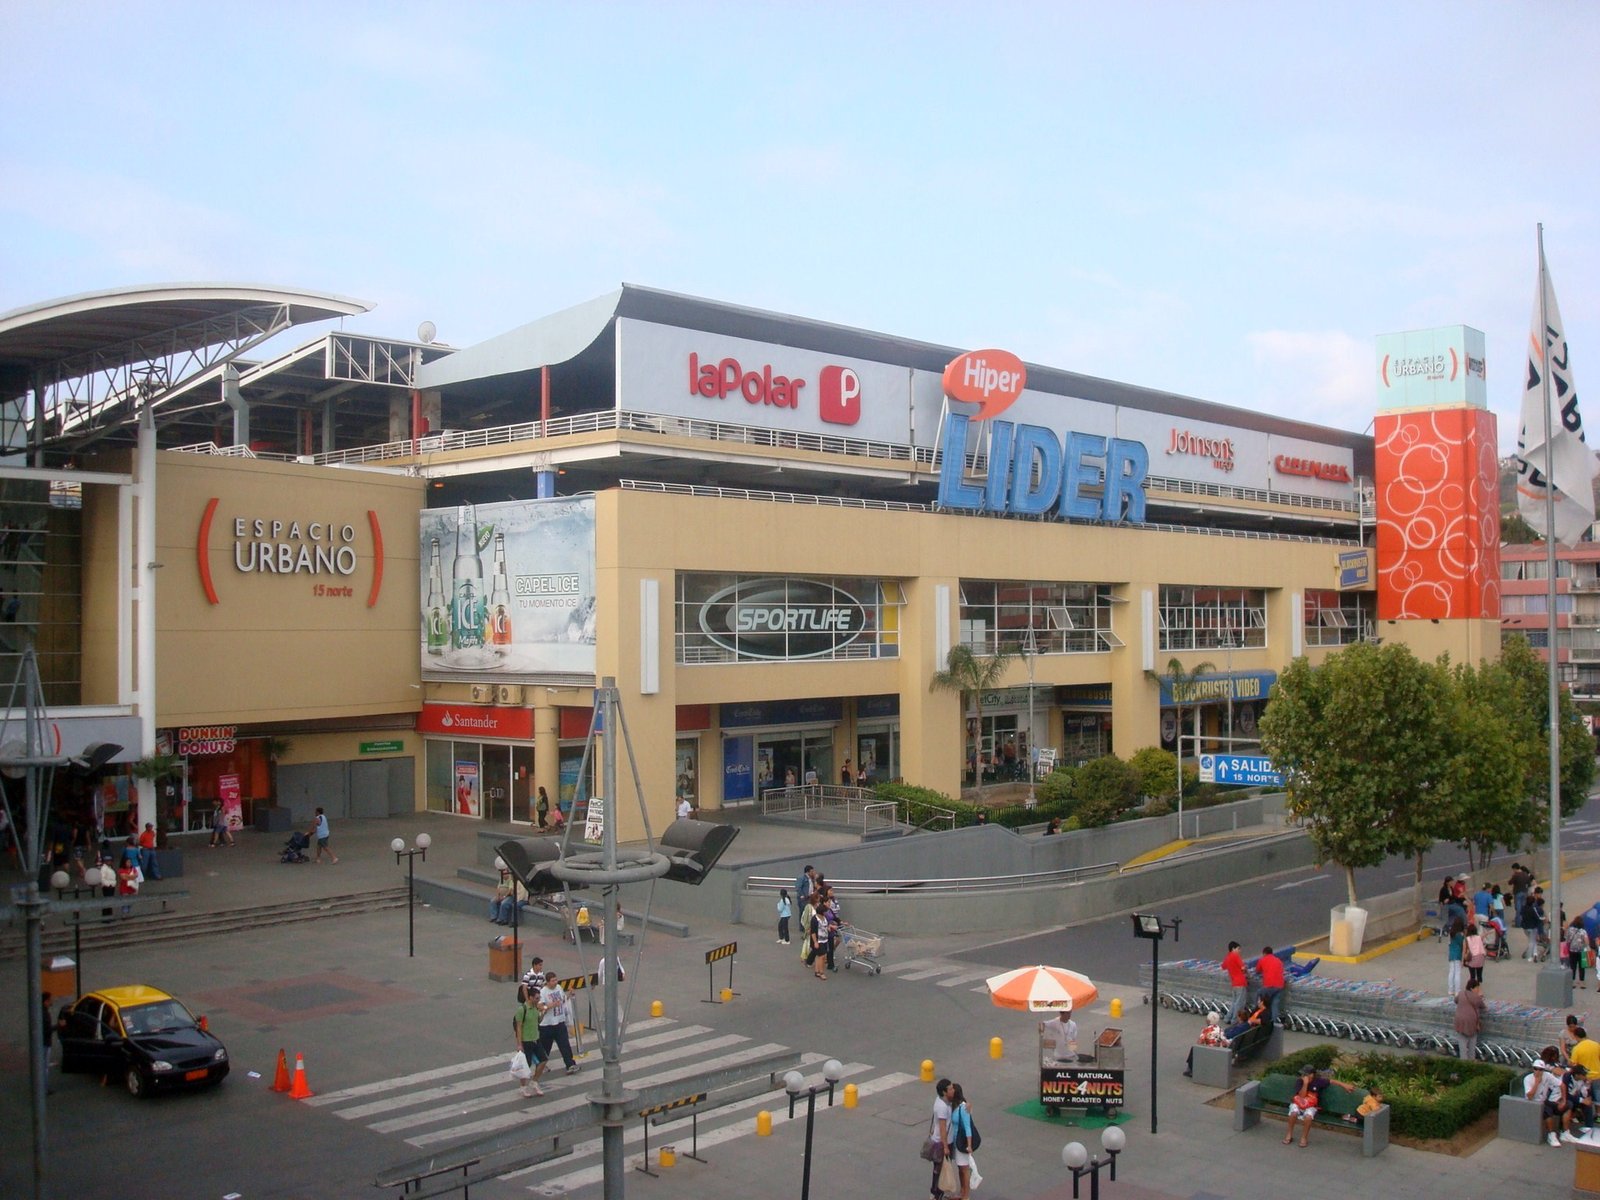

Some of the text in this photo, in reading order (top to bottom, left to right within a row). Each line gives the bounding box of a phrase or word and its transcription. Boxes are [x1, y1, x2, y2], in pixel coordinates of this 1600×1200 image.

[1394, 354, 1445, 367] ESPACIO
[963, 357, 1021, 395] Hiper
[1393, 361, 1446, 377] URBANO
[1166, 428, 1234, 460] Johnson's
[937, 412, 1150, 524] LIDER
[1274, 453, 1353, 483] CINEMARK
[234, 517, 356, 543] ESPACIO
[234, 541, 357, 576] URBANO
[312, 584, 354, 598] 15 norte
[515, 575, 580, 594] CAPEL ICE
[519, 598, 577, 608] TU MOMENTO ICE
[457, 599, 479, 631] ICE
[737, 608, 852, 631] SPORTLIFE
[1235, 678, 1261, 698] VIDEO
[454, 713, 498, 729] Santander
[179, 726, 237, 741] DUNKIN'
[1231, 758, 1281, 774] SALID
[1233, 774, 1243, 782] 15
[1056, 1071, 1114, 1080] ALL NATURAL
[1042, 1080, 1124, 1096] NUTS4NUTS
[1071, 1096, 1102, 1104] ROASTED
[1105, 1097, 1123, 1105] NUTS
